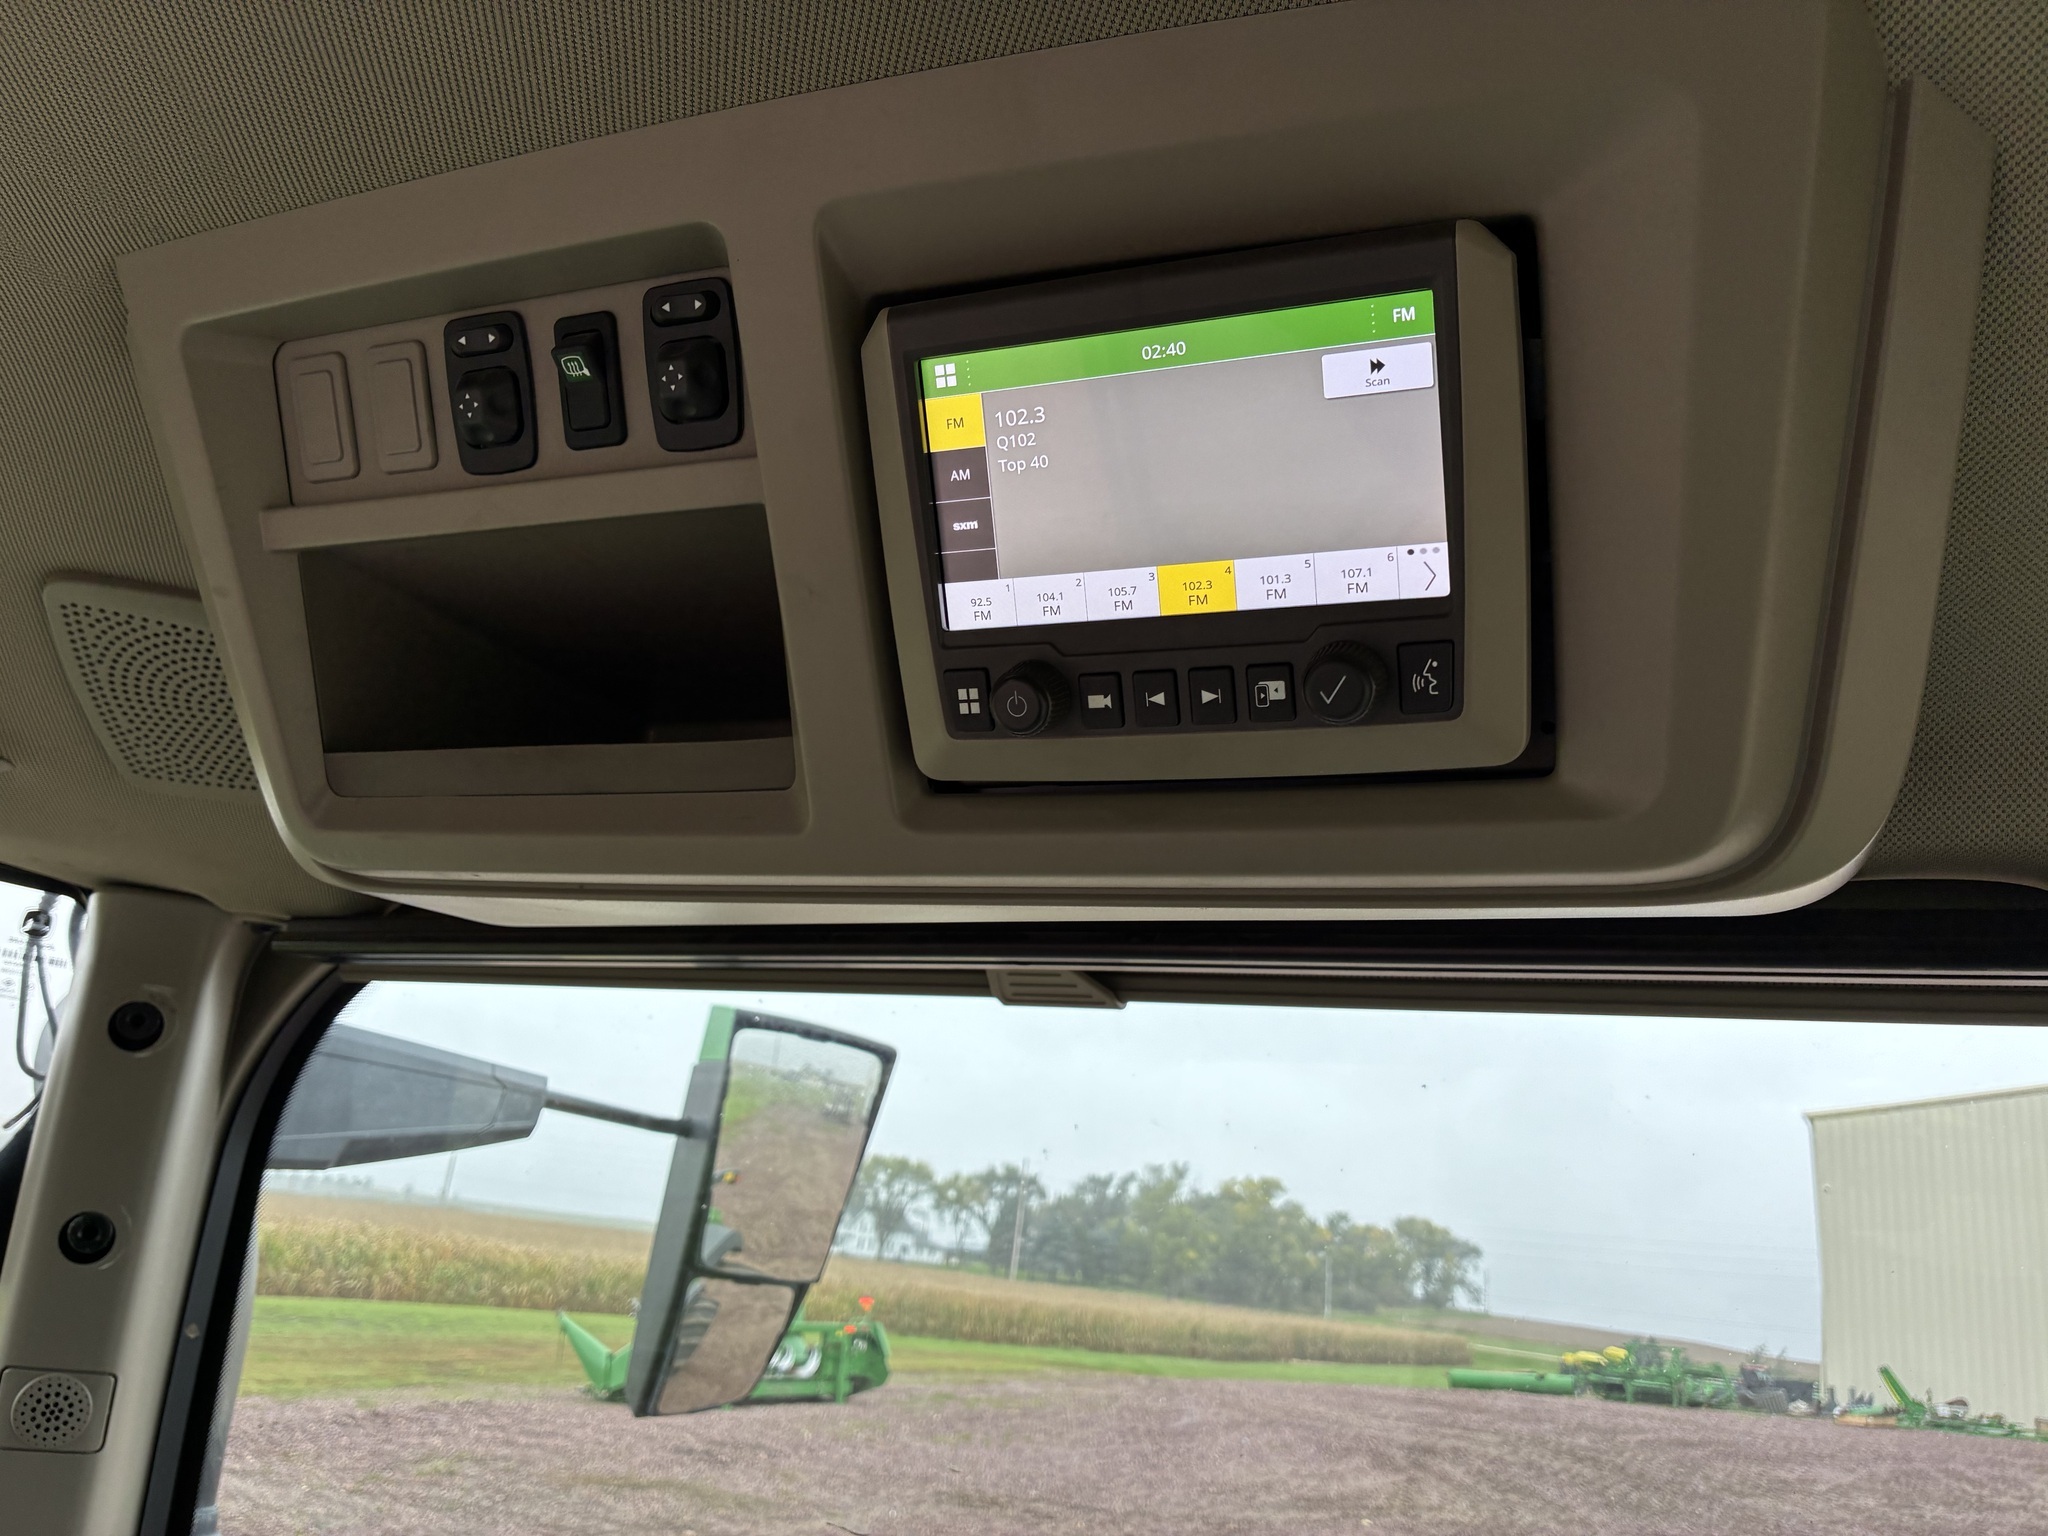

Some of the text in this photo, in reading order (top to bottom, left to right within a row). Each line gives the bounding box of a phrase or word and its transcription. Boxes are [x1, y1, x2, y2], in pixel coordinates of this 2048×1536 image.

[1392, 306, 1416, 323] FM
[1141, 341, 1187, 361] 02:40
[1364, 376, 1391, 388] Scan
[946, 416, 965, 430] FM
[995, 406, 1046, 428] 102.3
[996, 432, 1037, 451] Q102
[997, 454, 1049, 475] Top 40
[950, 468, 971, 482] AM
[1387, 552, 1395, 563] 6
[1303, 559, 1312, 569] 5
[1148, 571, 1155, 582] 3
[1224, 566, 1232, 575] 4
[1340, 567, 1373, 580] 107.1
[1075, 578, 1083, 588] 2
[1182, 579, 1213, 592] 102.3
[1259, 573, 1292, 586] 101.3
[1005, 584, 1011, 593] 1
[1107, 585, 1137, 598] 105.7
[1266, 588, 1288, 600] FM
[1346, 581, 1370, 595] FM
[970, 597, 993, 607] 92.5
[1036, 591, 1064, 603] 104.1
[1188, 594, 1209, 606] FM
[1042, 605, 1061, 617] FM
[1113, 600, 1134, 612] FM
[973, 610, 992, 622] FM
